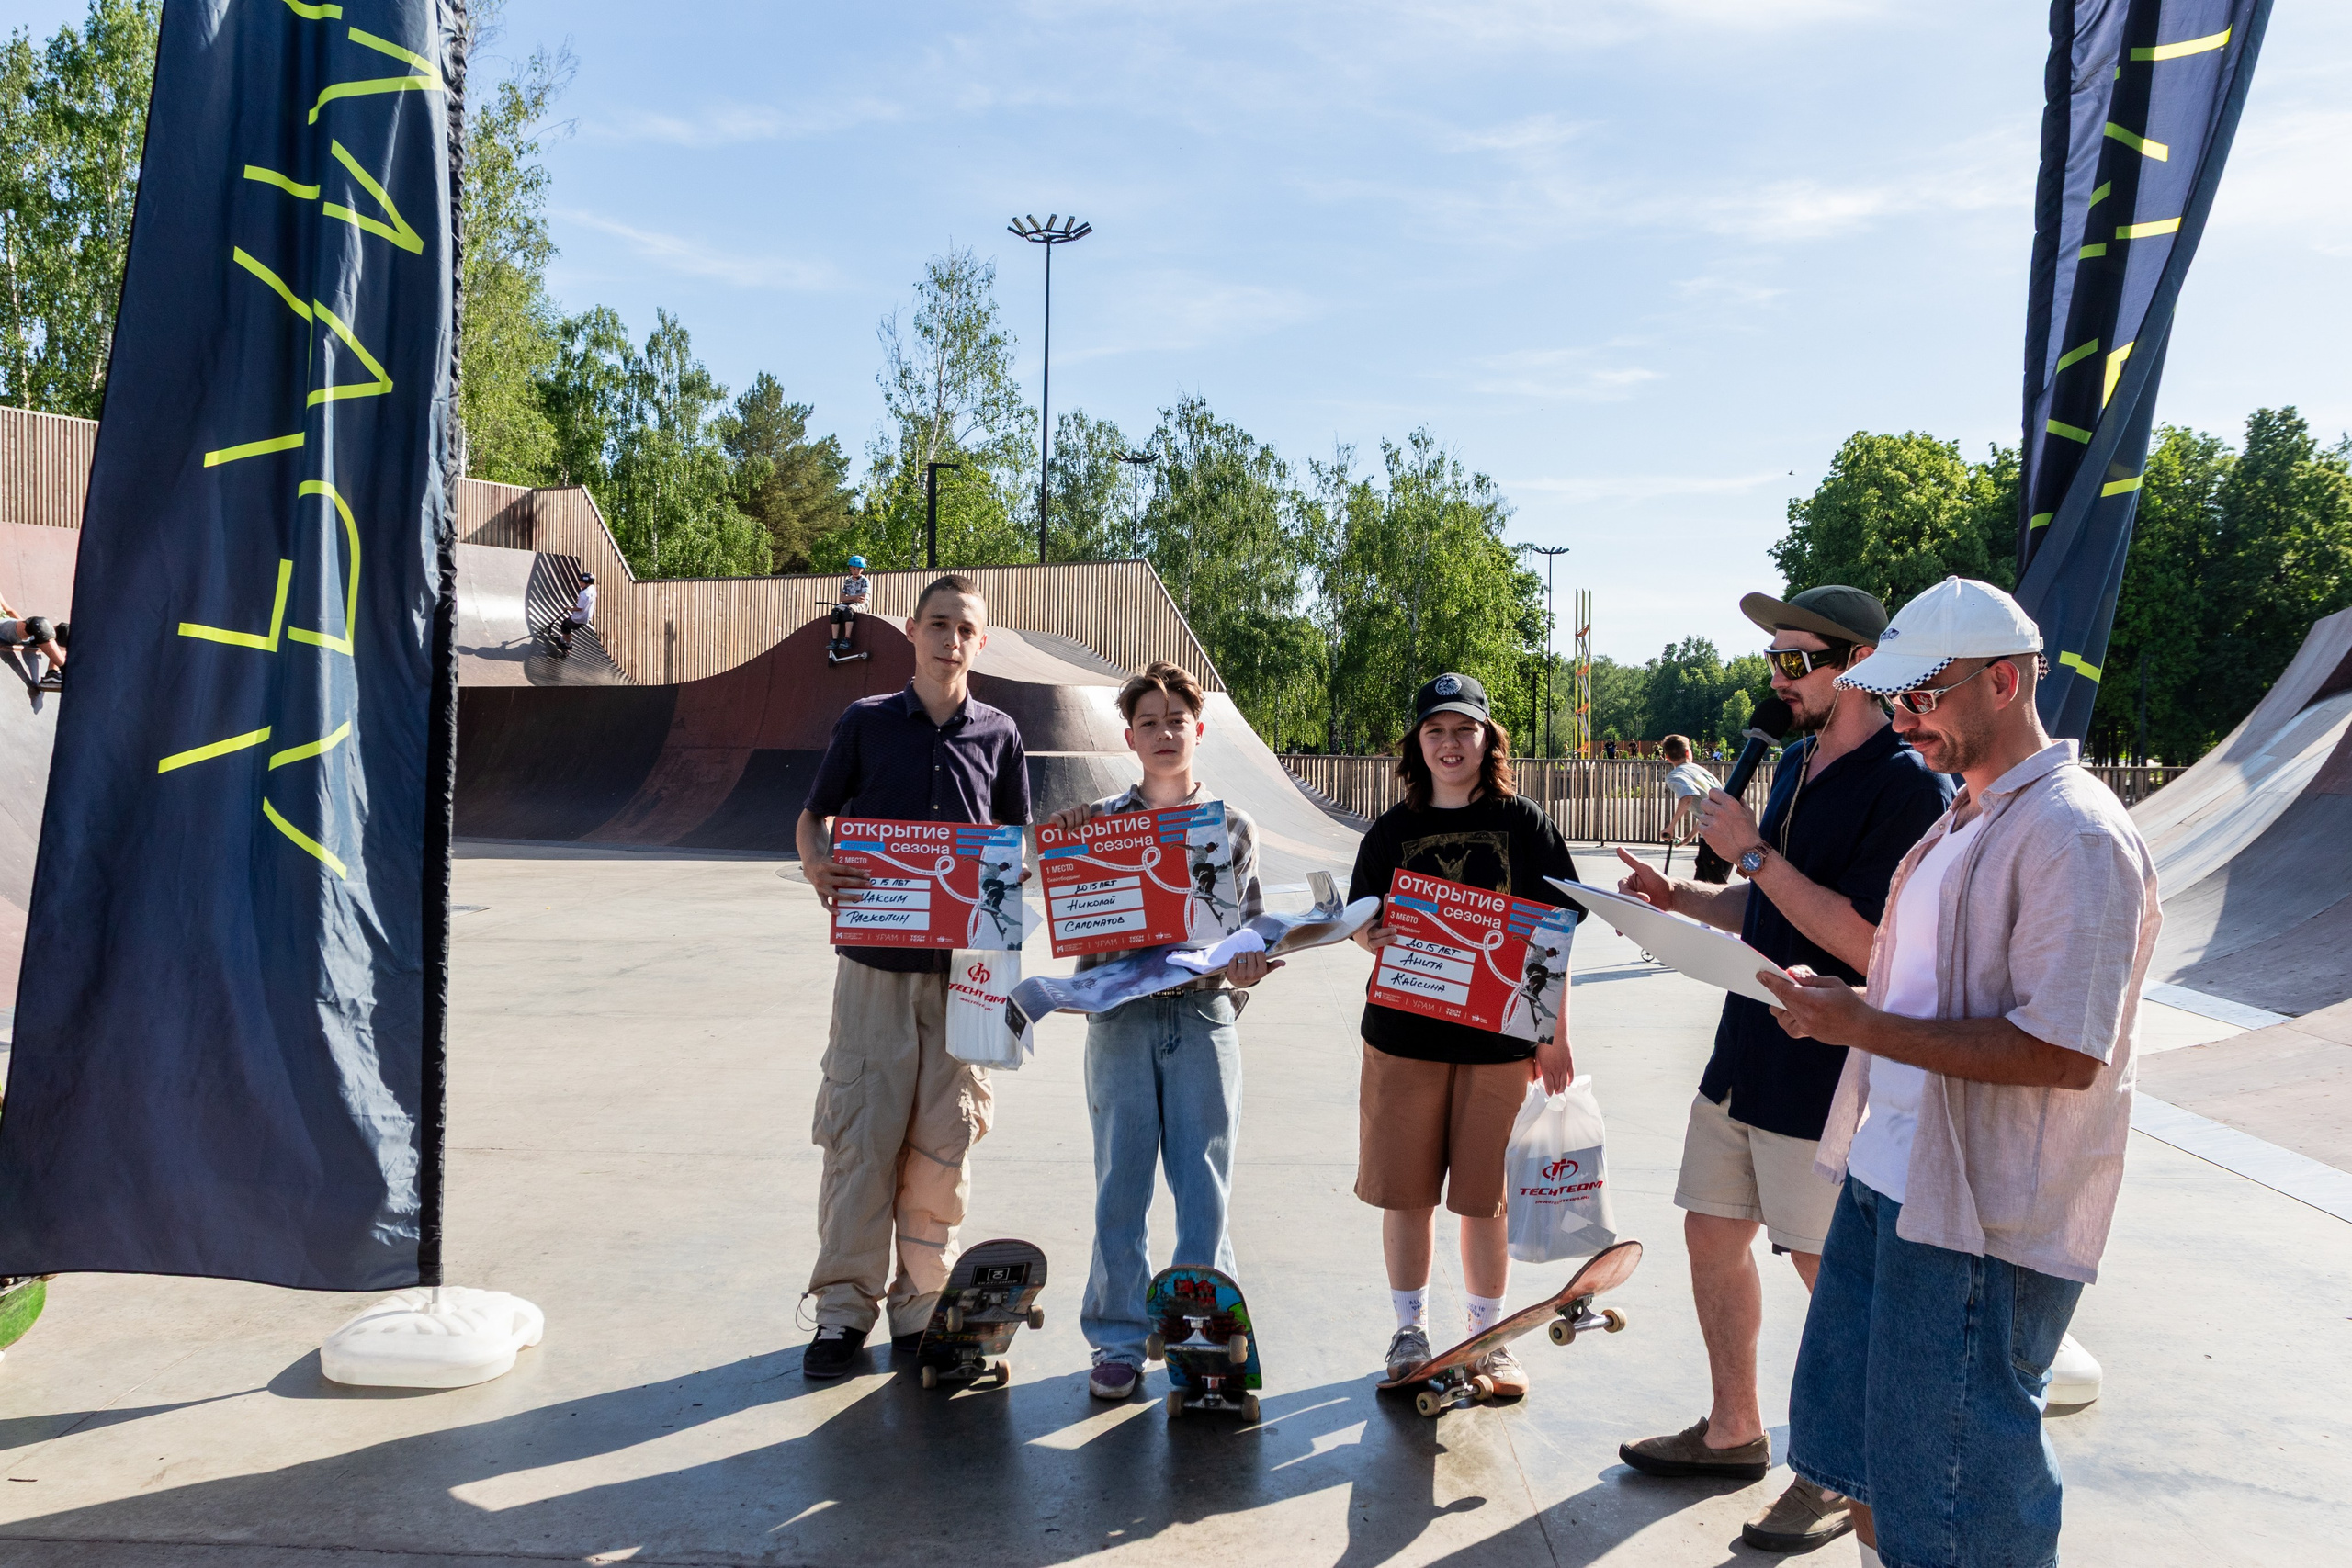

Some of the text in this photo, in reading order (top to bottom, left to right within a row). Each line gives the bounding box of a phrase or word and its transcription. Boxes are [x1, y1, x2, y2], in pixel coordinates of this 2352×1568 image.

[840, 822, 951, 842] открытие
[1040, 816, 1152, 844] открытие
[889, 841, 950, 855] сезона
[1093, 835, 1154, 853] сезона
[1051, 863, 1074, 874] МЕСТО
[1090, 882, 1098, 891] 15
[1099, 879, 1118, 889] ЛЕТ
[1397, 874, 1506, 913] открытие
[1399, 897, 1434, 911] летнего
[1396, 912, 1419, 924] МЕСТО
[1442, 906, 1502, 930] сезона
[1406, 938, 1461, 956] ДО 15 ЛЕТ
[949, 982, 1007, 1005] TECHTAM
[1520, 1180, 1603, 1196] TECHTEAM
